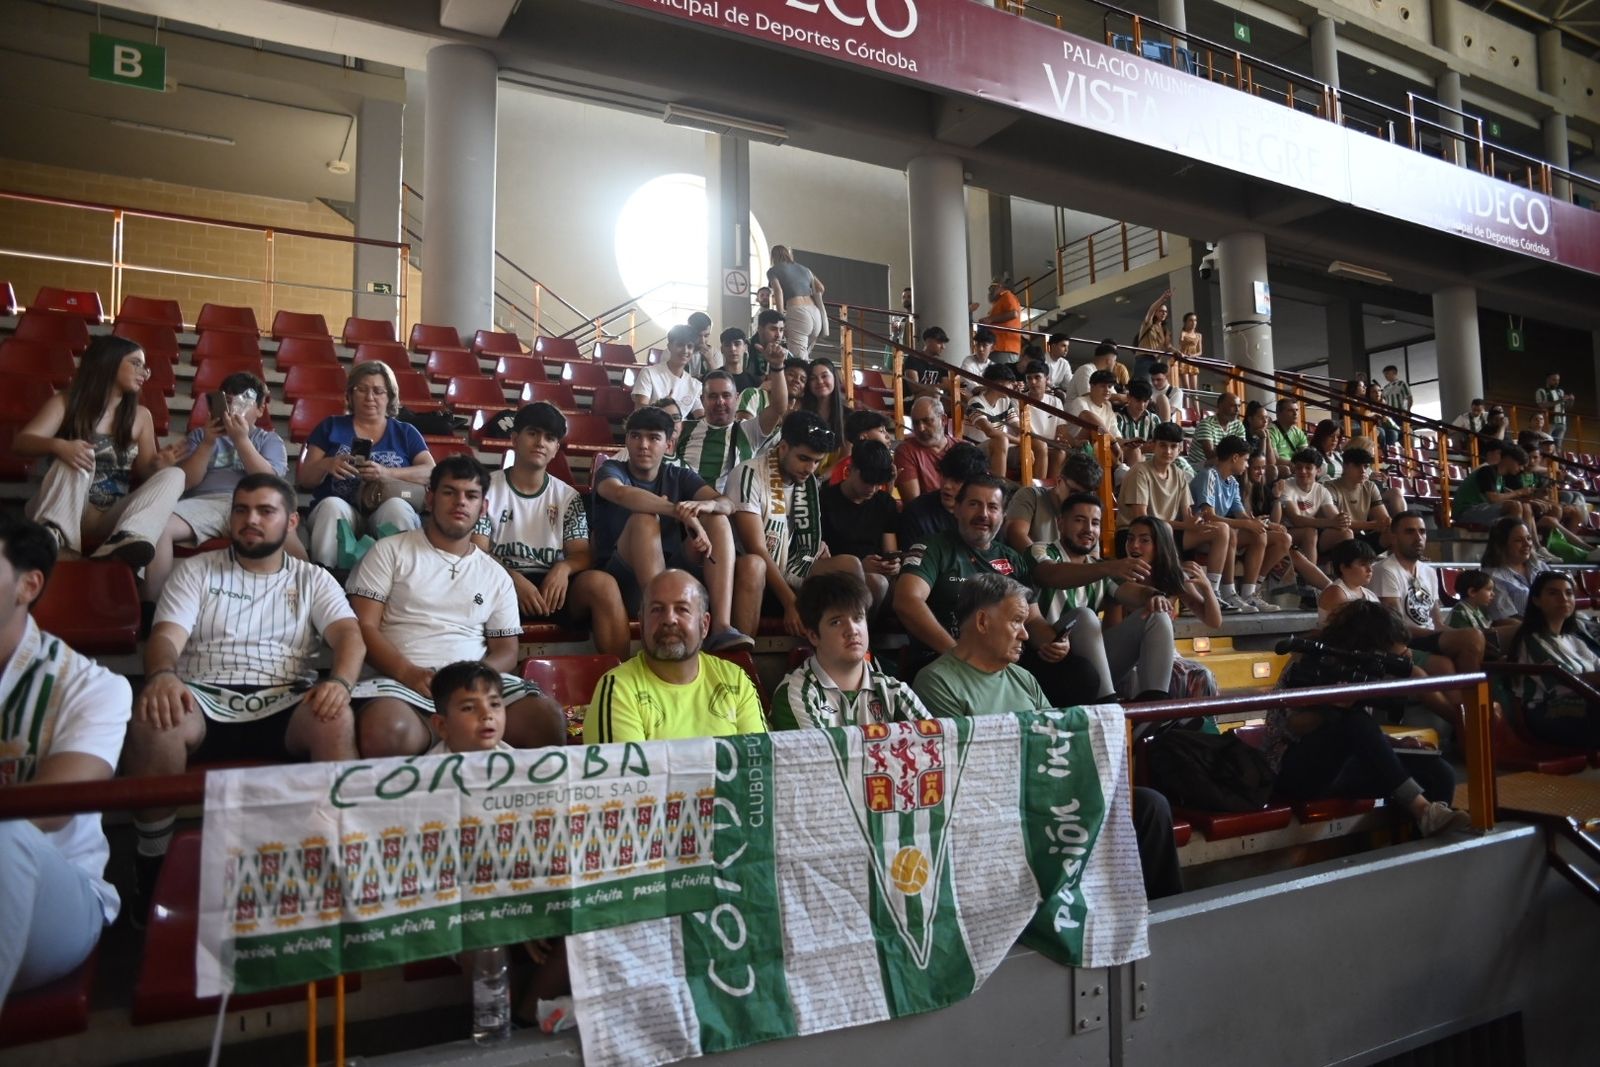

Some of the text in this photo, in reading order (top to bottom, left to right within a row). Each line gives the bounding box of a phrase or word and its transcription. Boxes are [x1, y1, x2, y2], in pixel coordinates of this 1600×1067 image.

[725, 7, 750, 26] de
[756, 13, 840, 50] Deportes
[845, 38, 918, 72] Córdoba
[1238, 27, 1245, 38] 4
[113, 44, 143, 78] B
[1063, 41, 1139, 81] PALACIO
[1043, 62, 1162, 128] VISTA
[1474, 226, 1484, 237] de
[1486, 227, 1519, 246] Deportes
[1520, 238, 1551, 256] Córdoba
[330, 741, 650, 808] CÓRDOBA
[1045, 798, 1089, 933] pasión
[545, 888, 623, 914] pasión infinita
[633, 873, 711, 897] pasión infinita
[344, 916, 436, 948] pasión infinita
[448, 902, 534, 930] pasión infinita
